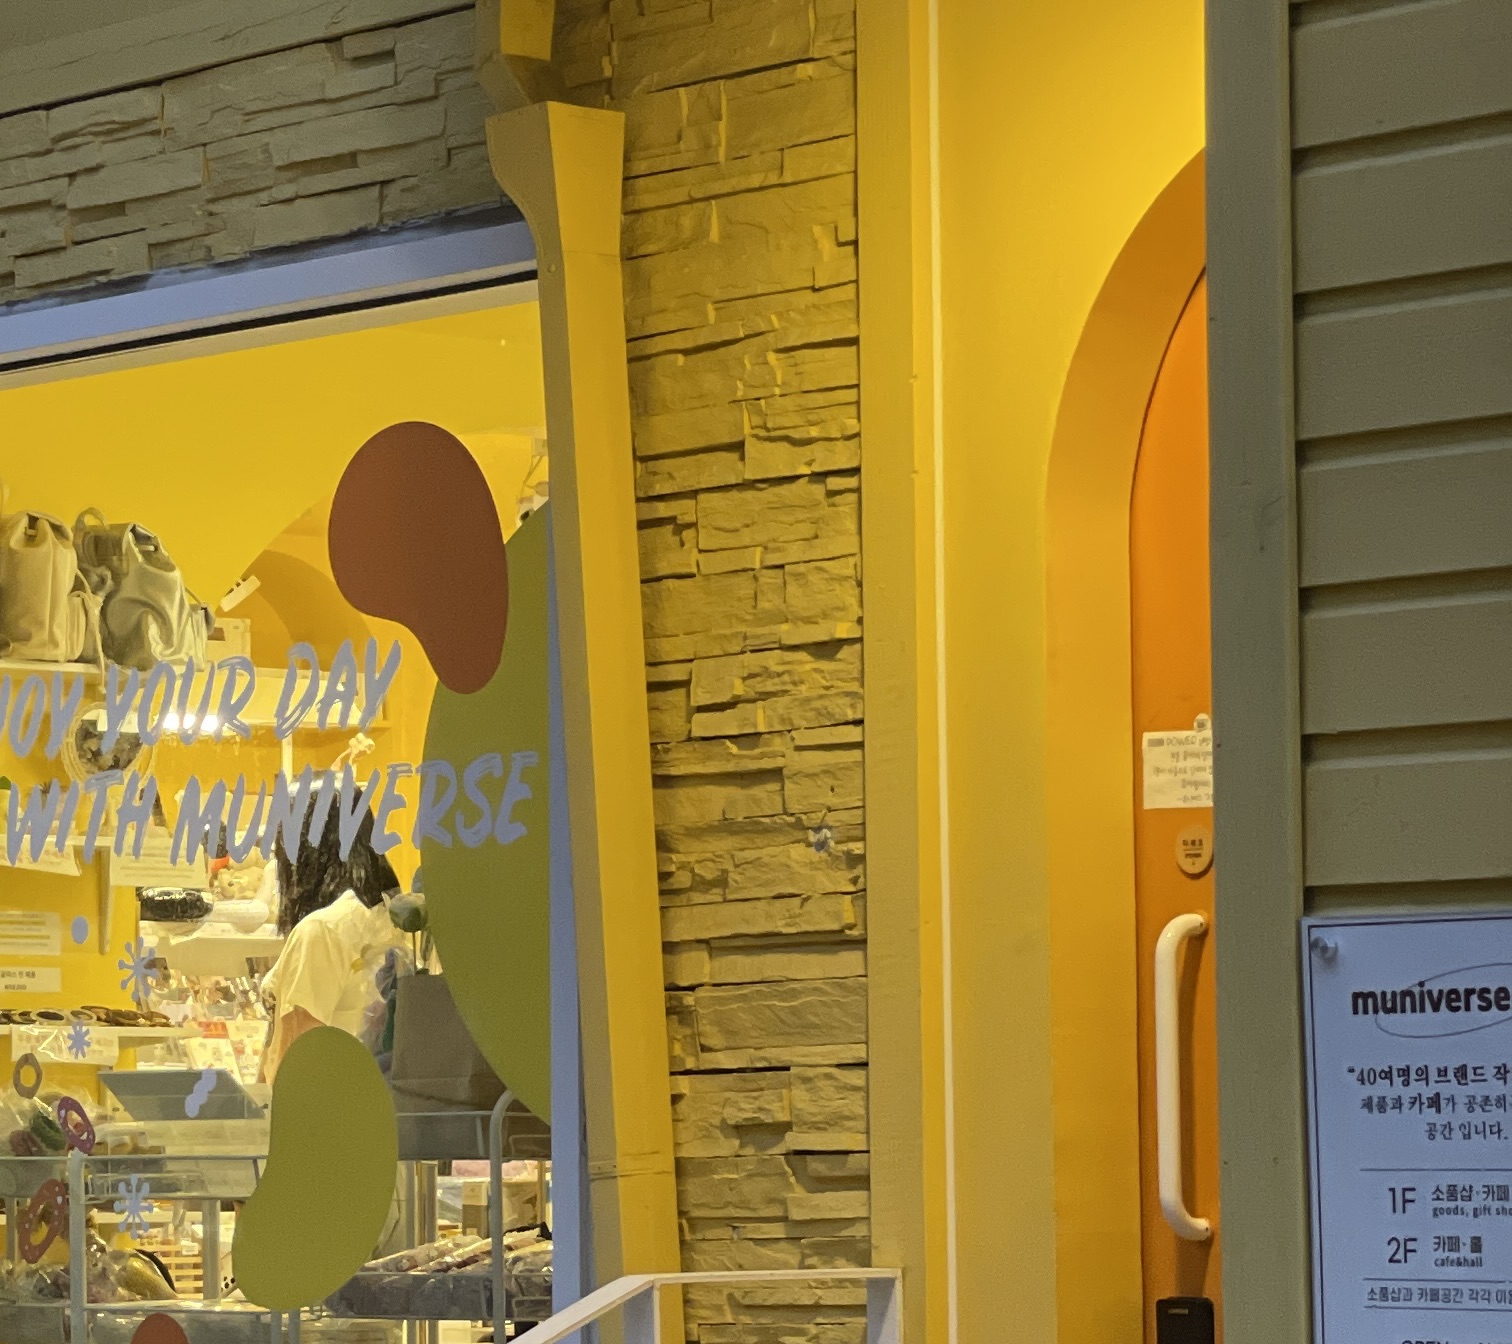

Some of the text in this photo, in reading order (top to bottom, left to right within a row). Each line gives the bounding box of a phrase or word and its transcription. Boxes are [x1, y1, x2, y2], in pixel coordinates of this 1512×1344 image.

[100, 655, 256, 756] YOUR
[274, 637, 402, 740] DAY
[6, 751, 538, 869] WITH MUNIVERSE
[1351, 981, 1511, 1015] muniverse
[1434, 1064, 1488, 1086] 브랜드
[1360, 1095, 1403, 1114] 제품과
[1408, 1092, 1457, 1115] 카페가
[1425, 1121, 1508, 1141] 공간 입니다.
[1388, 1187, 1416, 1214] 1F
[1432, 1205, 1469, 1218] goods,
[1472, 1205, 1492, 1218] gift
[1387, 1237, 1418, 1264] 2F
[1434, 1256, 1483, 1268] cafe&hall
[1468, 1289, 1491, 1304] 각각
